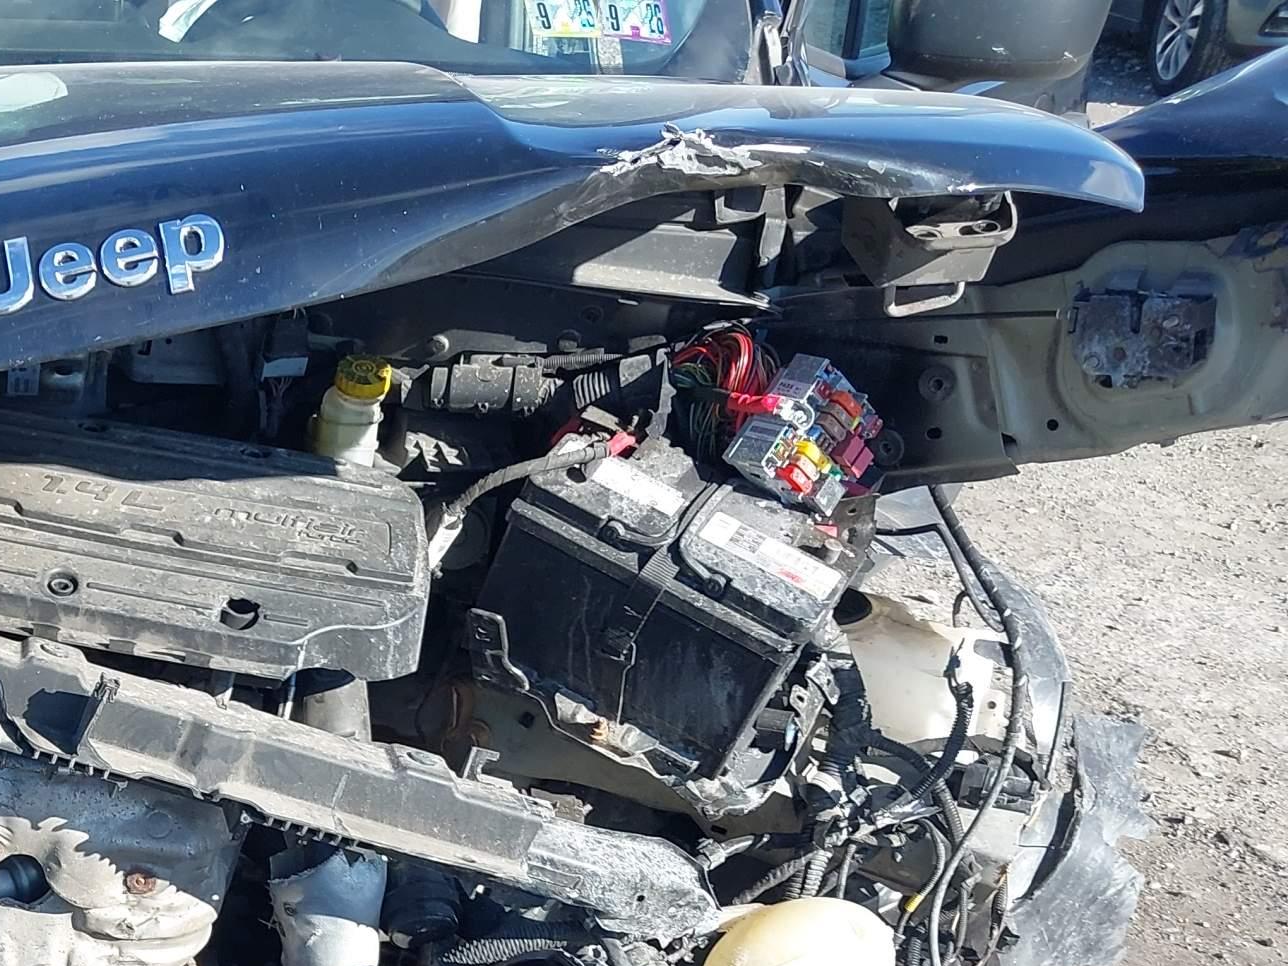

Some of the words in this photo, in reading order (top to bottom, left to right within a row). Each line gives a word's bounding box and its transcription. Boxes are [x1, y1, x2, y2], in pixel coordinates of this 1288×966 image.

[536, 2, 552, 30] 9
[608, 3, 620, 32] 9
[646, 3, 665, 35] 26
